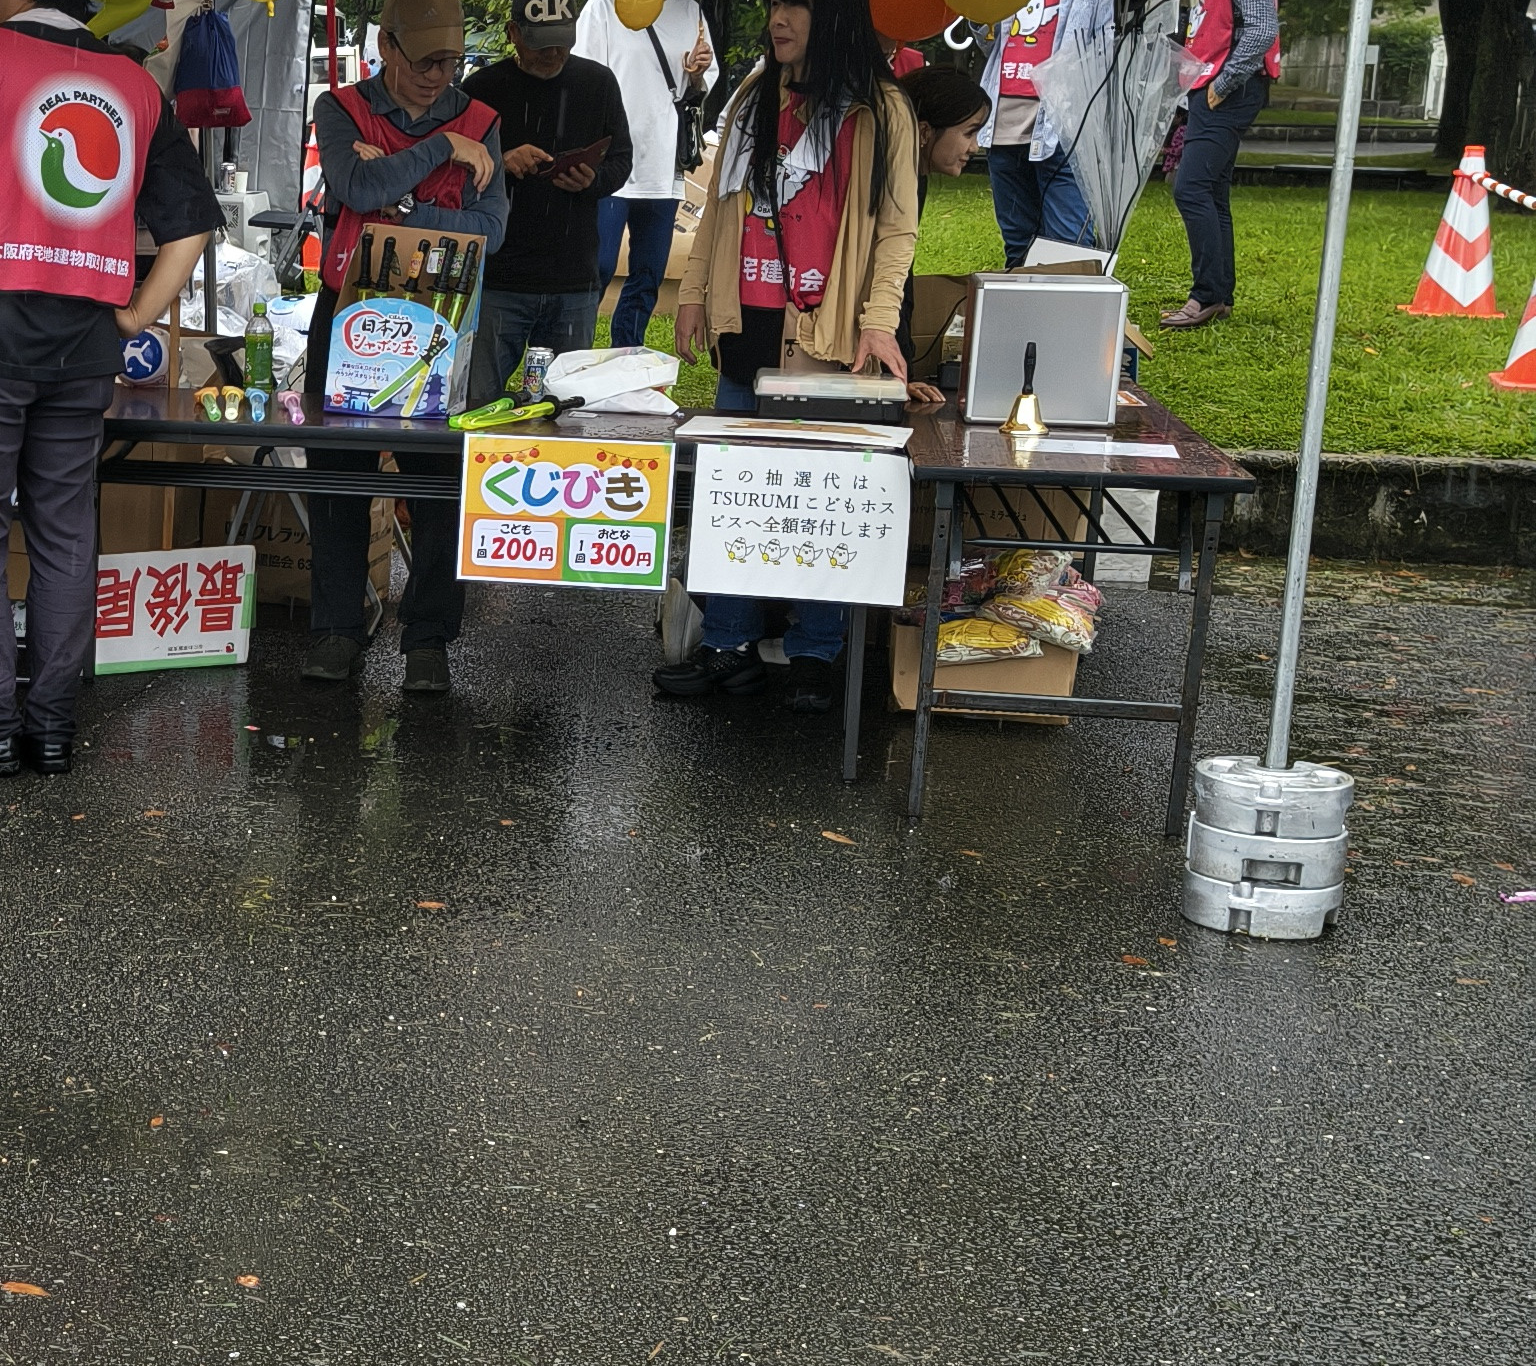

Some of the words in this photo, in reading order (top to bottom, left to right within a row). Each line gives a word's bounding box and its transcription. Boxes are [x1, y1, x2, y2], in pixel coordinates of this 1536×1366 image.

[38, 91, 71, 116] REAL
[73, 90, 124, 129] PARTNER
[361, 317, 413, 340] 日本刀
[353, 333, 418, 356] シャボン玉
[484, 465, 644, 513] くじびき
[711, 468, 888, 493] この抽選代は、
[499, 523, 532, 535] こども
[597, 528, 631, 541] おとな
[710, 515, 893, 540] ピスへ全額寄付します
[476, 535, 487, 559] 1回
[490, 536, 554, 562] 200円
[574, 539, 586, 564] 1回
[590, 542, 652, 567] 300円
[95, 560, 244, 639] 最後尾
